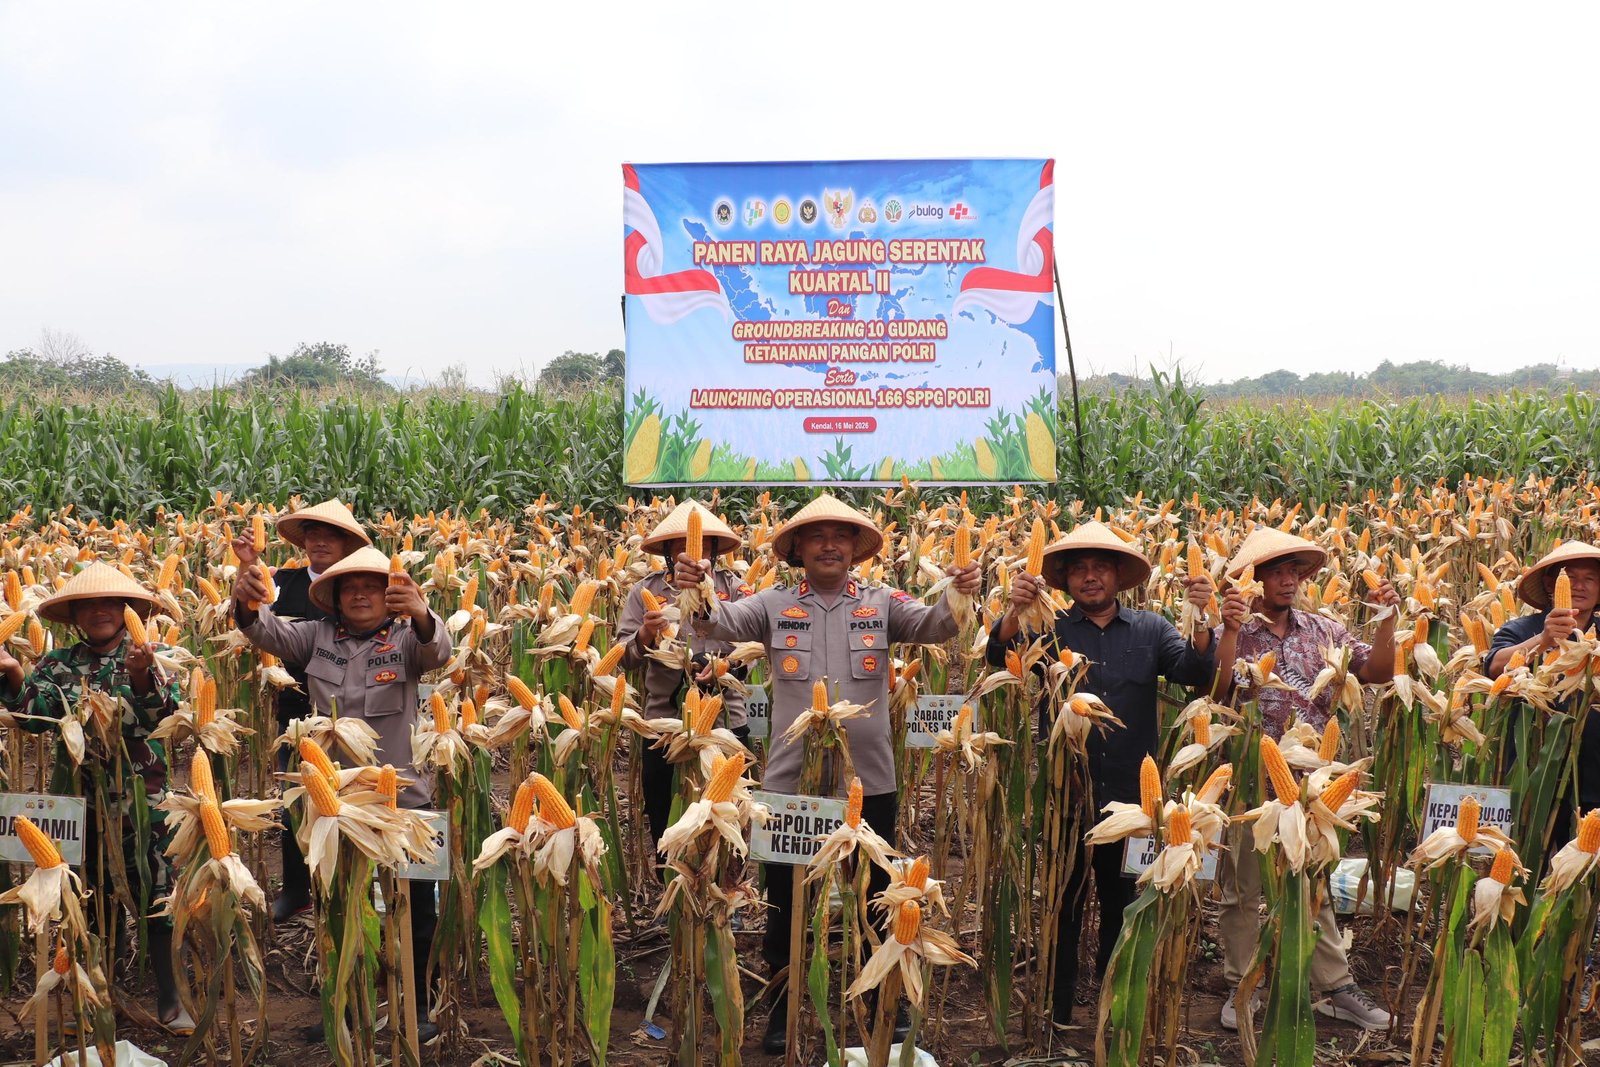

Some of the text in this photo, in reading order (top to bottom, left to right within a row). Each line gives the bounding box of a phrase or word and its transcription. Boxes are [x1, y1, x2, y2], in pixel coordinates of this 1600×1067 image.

[916, 204, 944, 219] bulog
[694, 240, 985, 263] PANEN RAYA JAGUNG SERENTAK
[789, 271, 889, 293] KUARTAL II
[827, 299, 851, 315] Dan
[732, 321, 947, 338] GROUNDBREAKING 10 GUDANG
[745, 344, 934, 361] KETAHANAN PANGAN POLRI
[825, 369, 855, 385] Serta
[690, 389, 989, 407] LAUNCHING OPERASIONAL 166 SPPG POLRI
[811, 422, 834, 431] Kendal,
[835, 422, 843, 430] 16
[843, 422, 854, 430] Mei
[777, 620, 811, 631] HENDRY
[850, 620, 883, 631] POLRI
[367, 653, 402, 668] POLRI
[1429, 803, 1458, 819] KEPA
